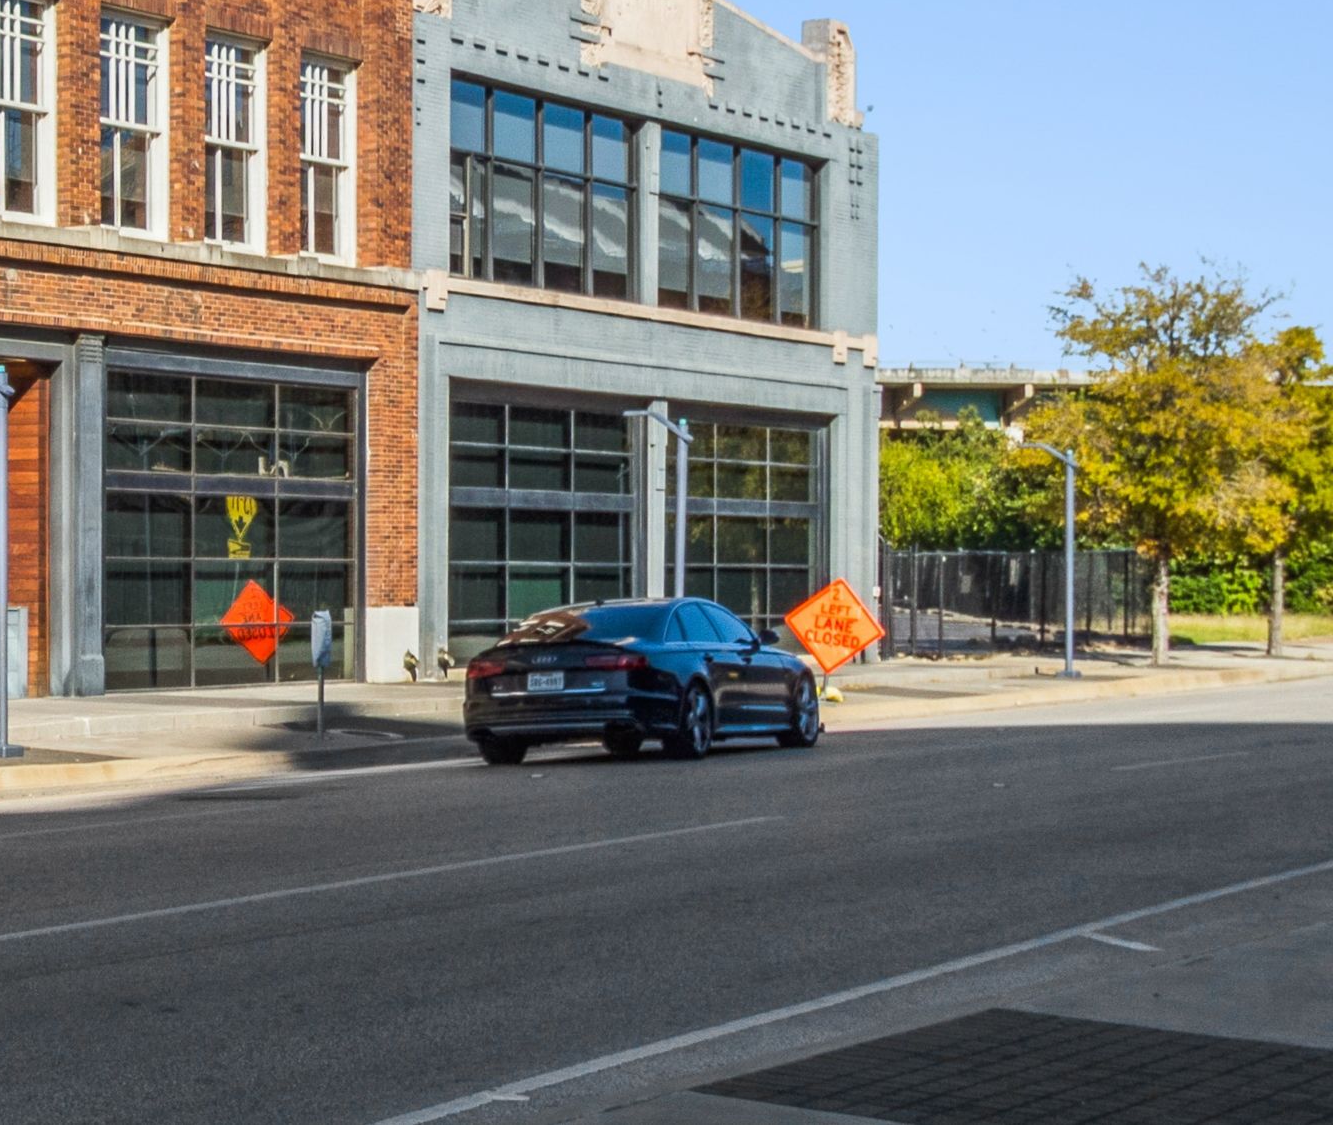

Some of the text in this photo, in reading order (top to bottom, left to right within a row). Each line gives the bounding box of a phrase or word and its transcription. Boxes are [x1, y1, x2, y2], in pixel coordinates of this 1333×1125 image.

[832, 587, 841, 601] 2
[820, 603, 852, 616] LEFT
[814, 615, 858, 634] LANE
[804, 629, 860, 649] CLOSED
